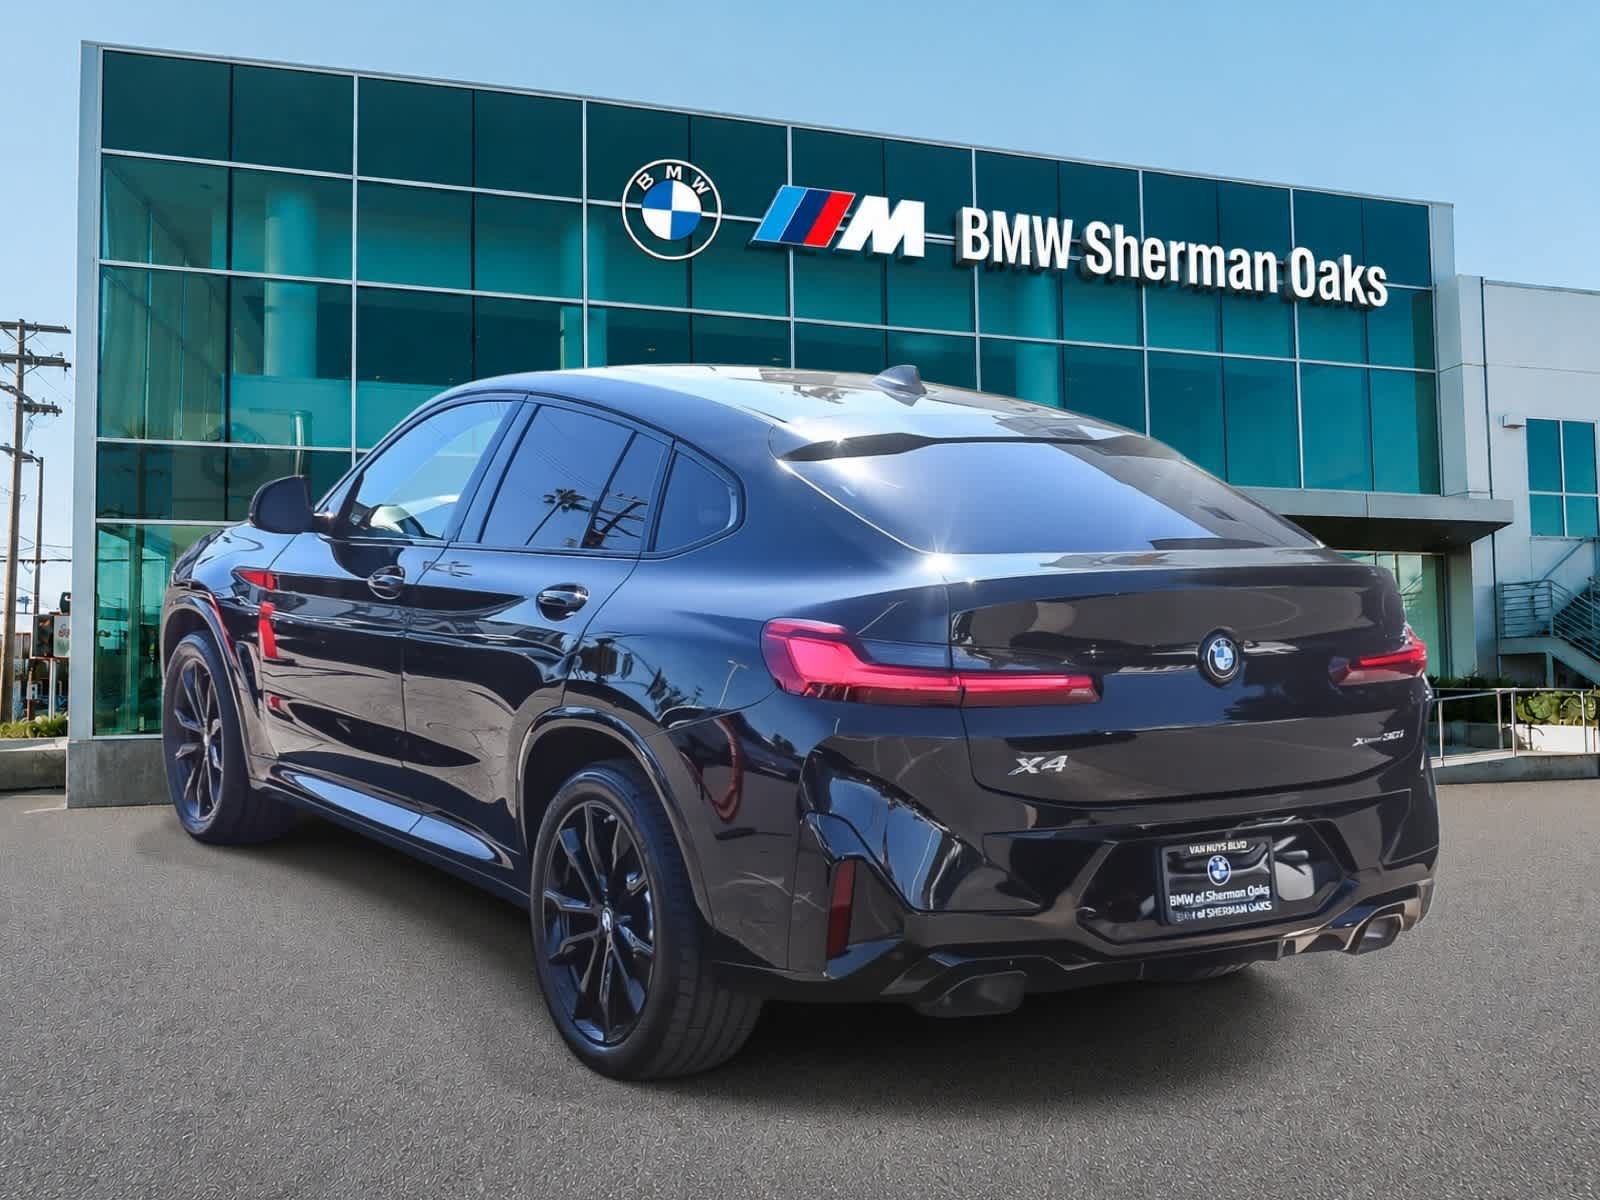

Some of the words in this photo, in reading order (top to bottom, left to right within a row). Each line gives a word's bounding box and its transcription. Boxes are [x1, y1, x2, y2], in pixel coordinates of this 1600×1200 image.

[636, 164, 711, 196] BMW
[961, 206, 1073, 270] BMW
[1084, 220, 1278, 294] Sherman
[1289, 246, 1388, 308] Oaks
[1007, 755, 1069, 776] X4
[1189, 844, 1206, 855] VAN
[1206, 842, 1227, 853] NUYS
[1227, 840, 1248, 851] BLVD
[1169, 893, 1193, 906] BMW
[1195, 891, 1205, 903] of
[1206, 889, 1246, 902] Sherman
[1247, 884, 1270, 896] Oaks
[1206, 904, 1248, 918] SHERMAN
[1248, 901, 1273, 913] OAKS
